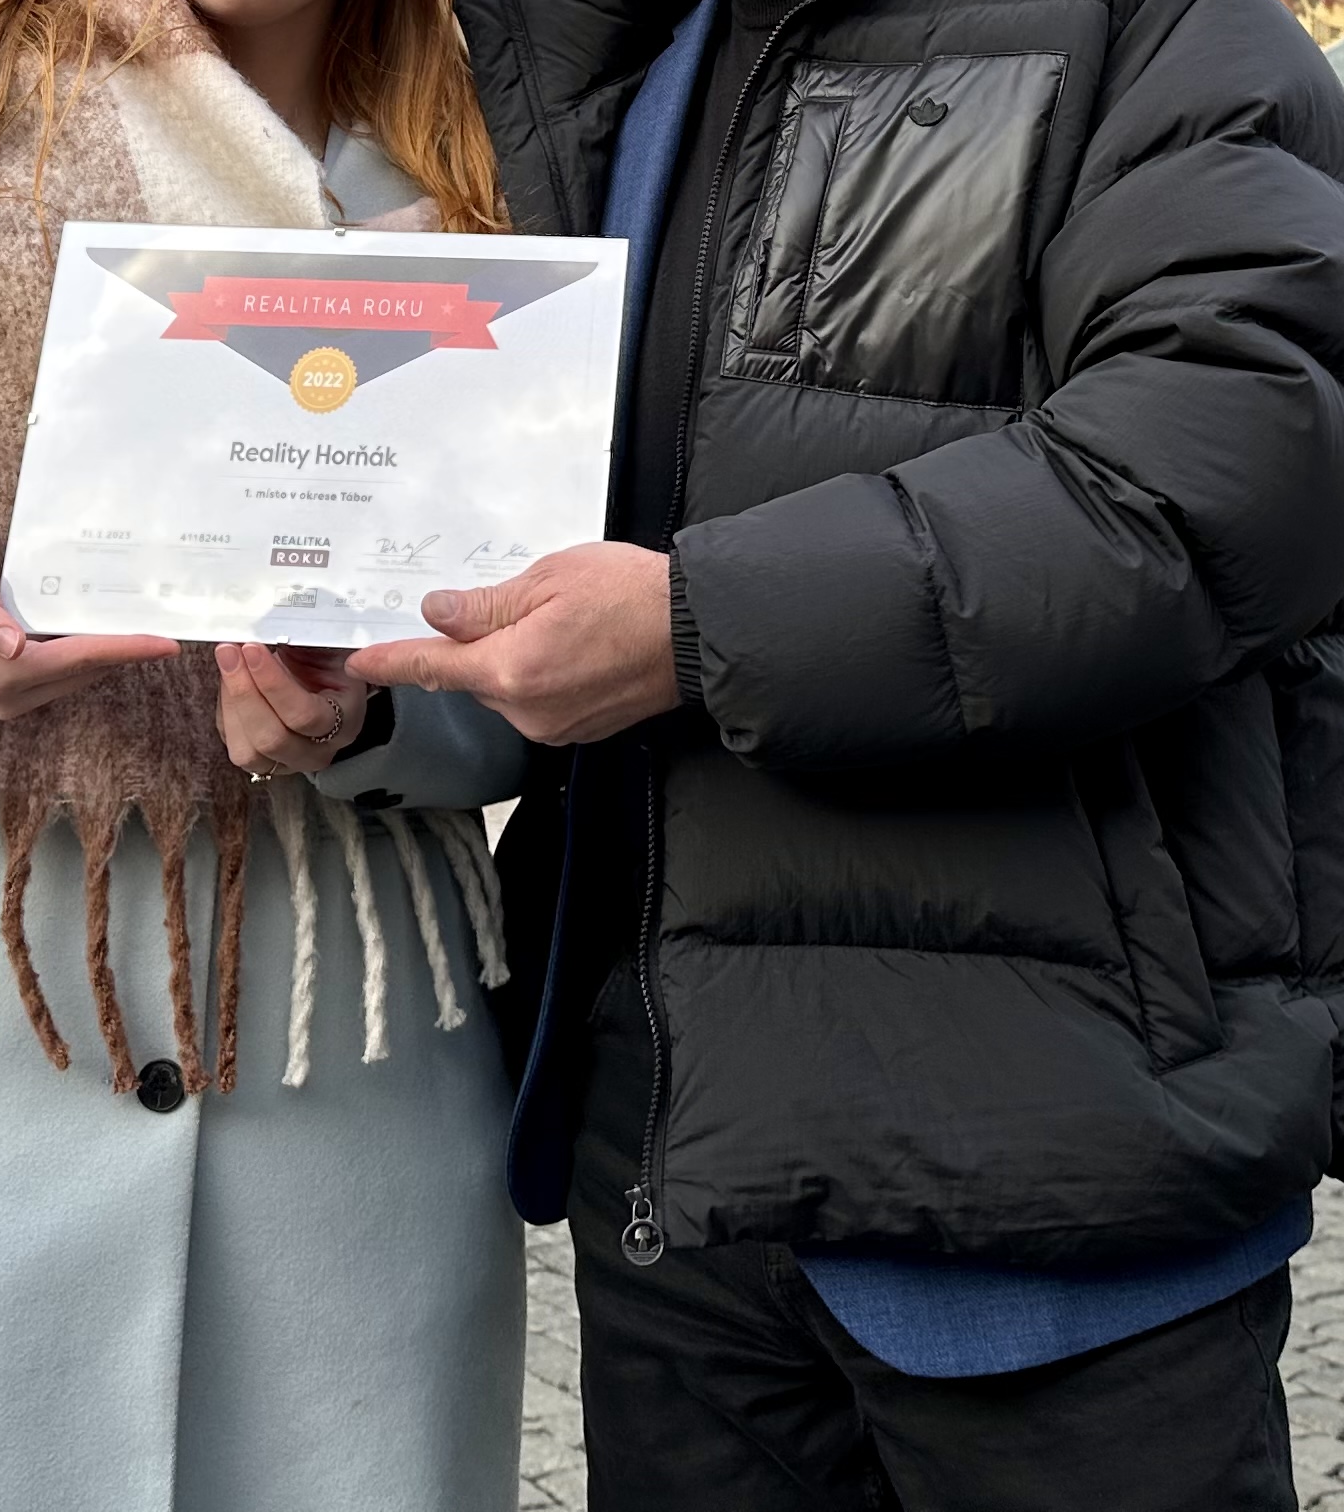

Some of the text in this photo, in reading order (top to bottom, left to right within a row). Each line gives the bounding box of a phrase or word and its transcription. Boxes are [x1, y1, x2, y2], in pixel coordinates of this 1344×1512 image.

[243, 294, 424, 317] REALITKA ROKU
[302, 370, 345, 389] 2022
[229, 441, 398, 470] Reality Horňák
[255, 488, 287, 500] místo
[290, 491, 297, 499] v
[299, 491, 337, 501] okrese
[340, 491, 373, 503] Tábor
[272, 535, 331, 548] REALITKA
[275, 551, 325, 565] ROKU
